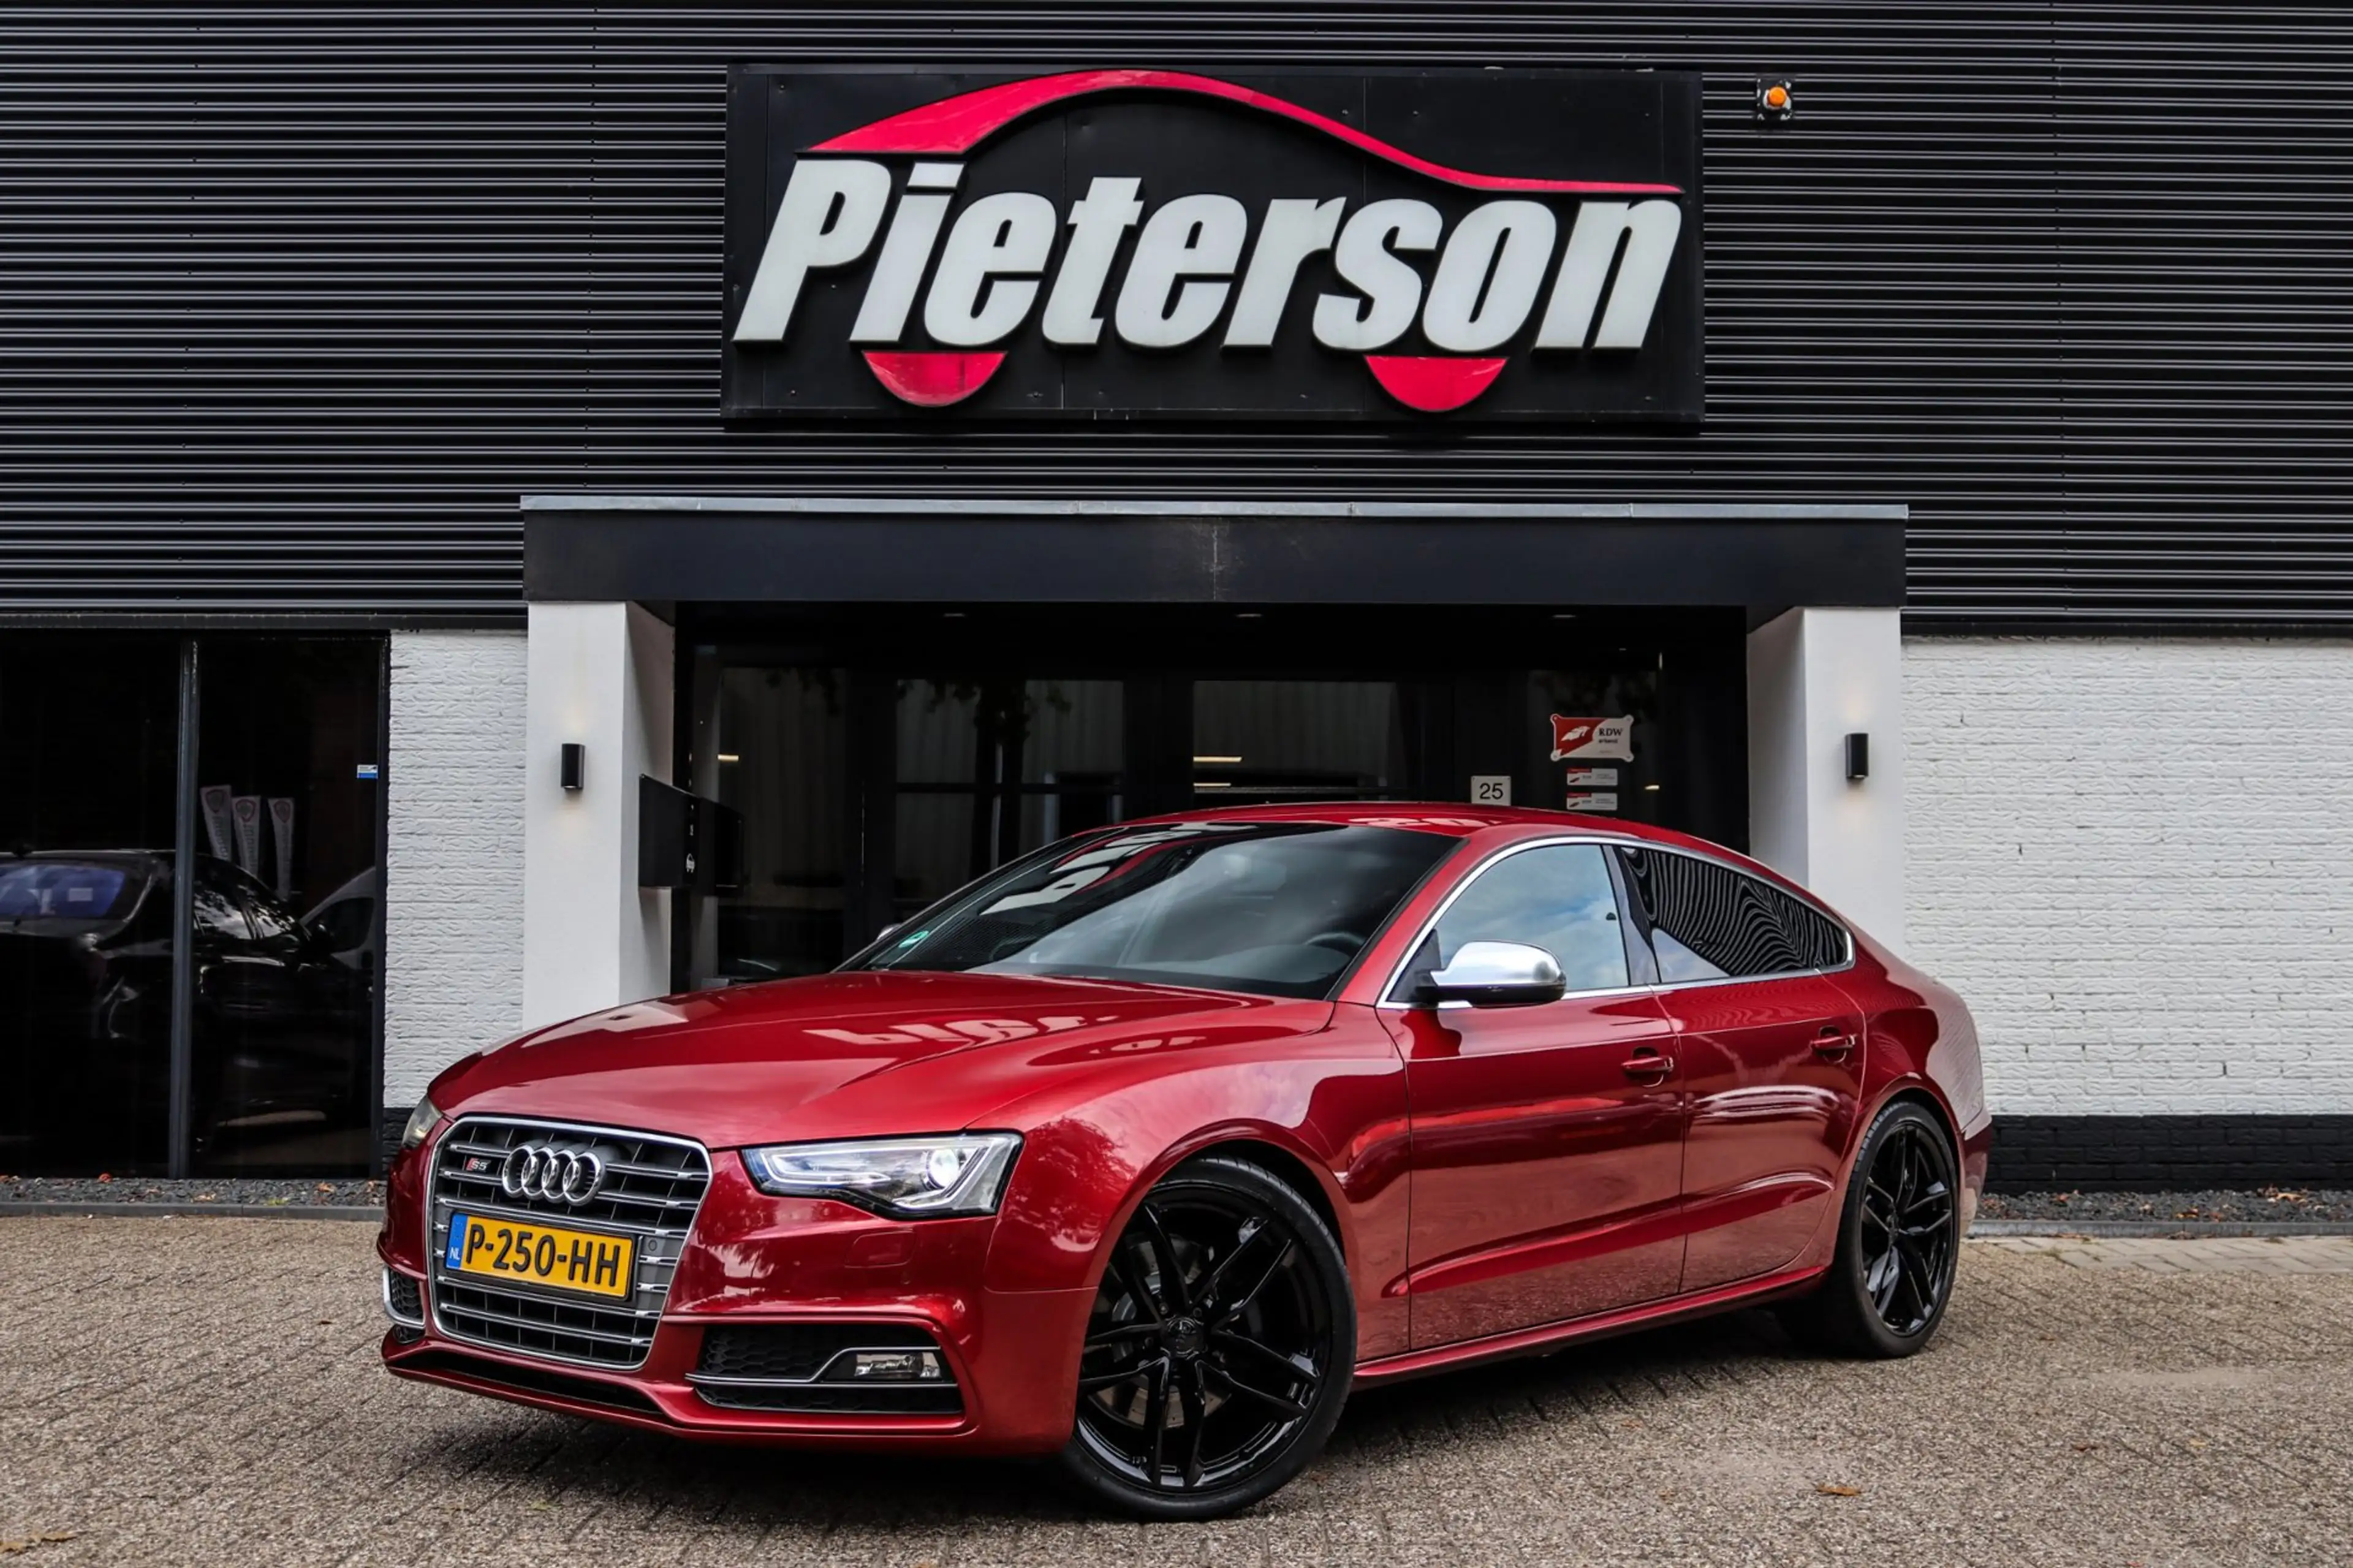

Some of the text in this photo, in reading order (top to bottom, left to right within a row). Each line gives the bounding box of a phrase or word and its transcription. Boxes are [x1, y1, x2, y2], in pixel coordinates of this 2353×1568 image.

[732, 159, 1682, 352] Pieterson
[1599, 728, 1624, 737] RDW
[1479, 782, 1504, 800] 25
[471, 1160, 488, 1172] S5
[449, 1246, 460, 1261] NL
[466, 1224, 620, 1287] P-250-HH
